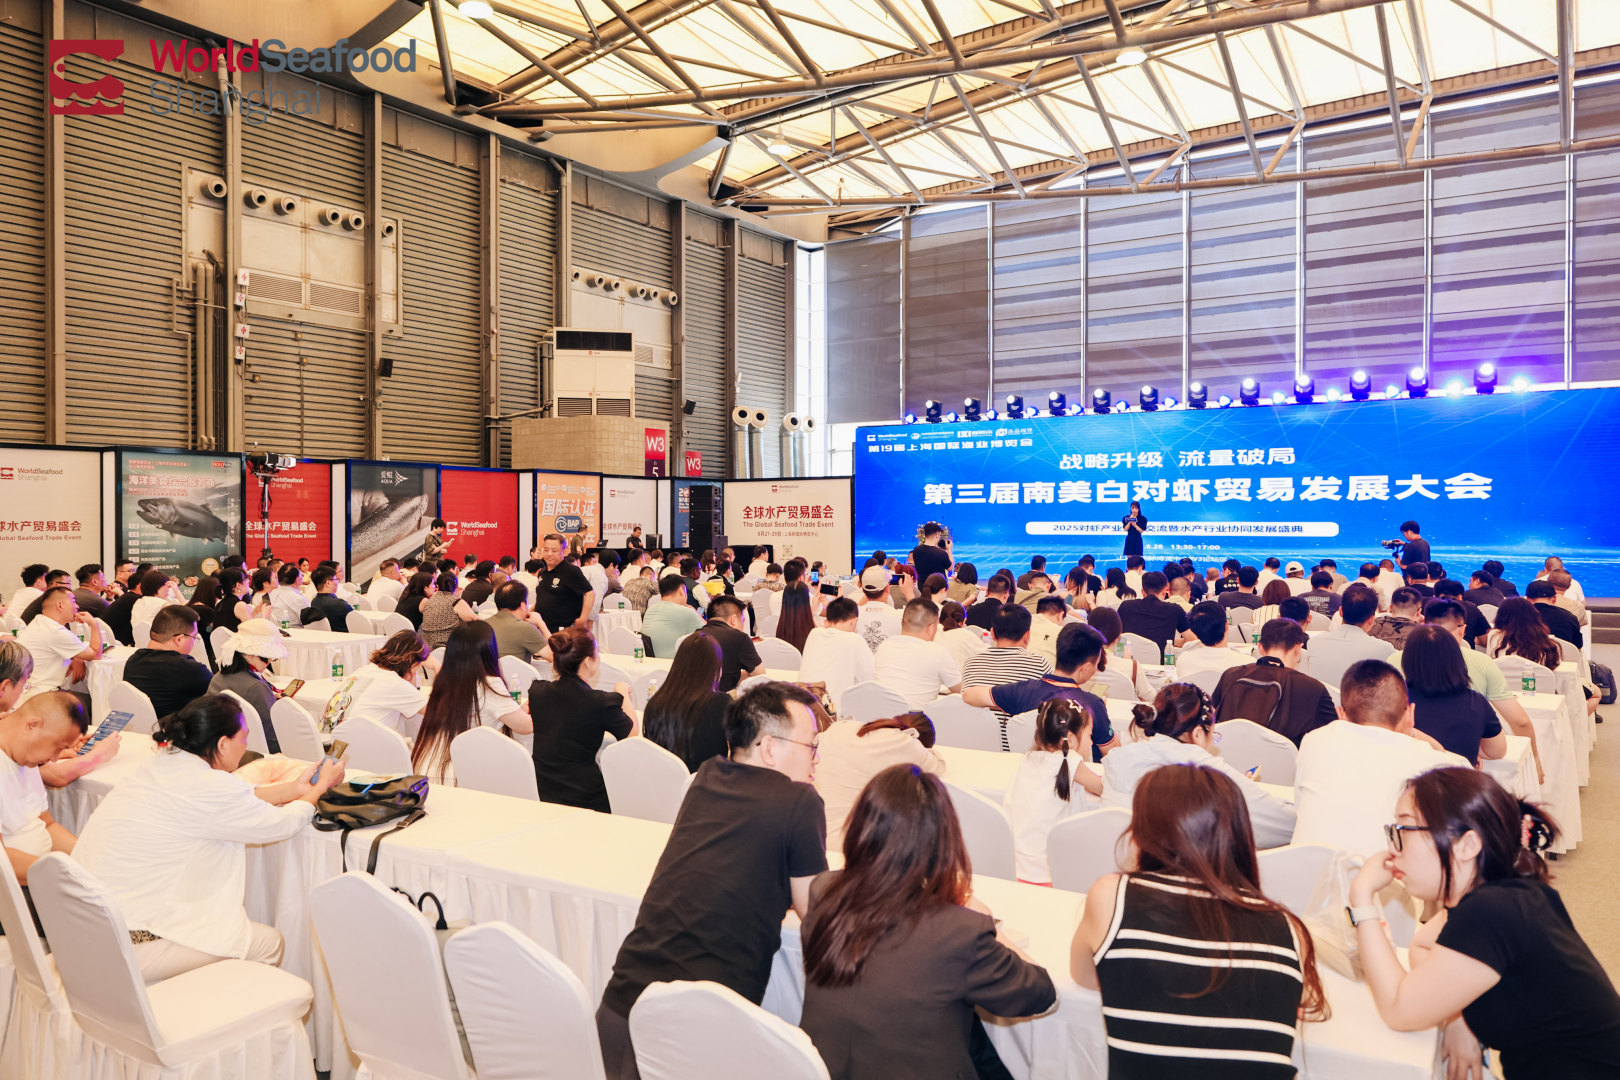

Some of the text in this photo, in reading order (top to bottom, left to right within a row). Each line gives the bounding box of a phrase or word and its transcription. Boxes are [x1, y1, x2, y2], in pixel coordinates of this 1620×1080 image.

[646, 436, 665, 452] W3
[868, 438, 1033, 453] 第19届上海国际渔业博览会
[686, 457, 701, 471] W3
[1059, 447, 1295, 470] 战略升级 流量破局
[652, 466, 659, 477] 5
[923, 472, 1494, 505] 第三届南美白对虾贸易发展大会
[541, 498, 596, 517] 国际认证
[742, 504, 834, 519] 全球水产贸易盛会
[460, 521, 498, 529] WorldSeafood
[567, 519, 580, 528] BAP
[817, 520, 834, 528] Event
[1053, 524, 1304, 533] 2025对虾产业交流暨水产行业协同发展盛典
[460, 529, 486, 538] Shanghai
